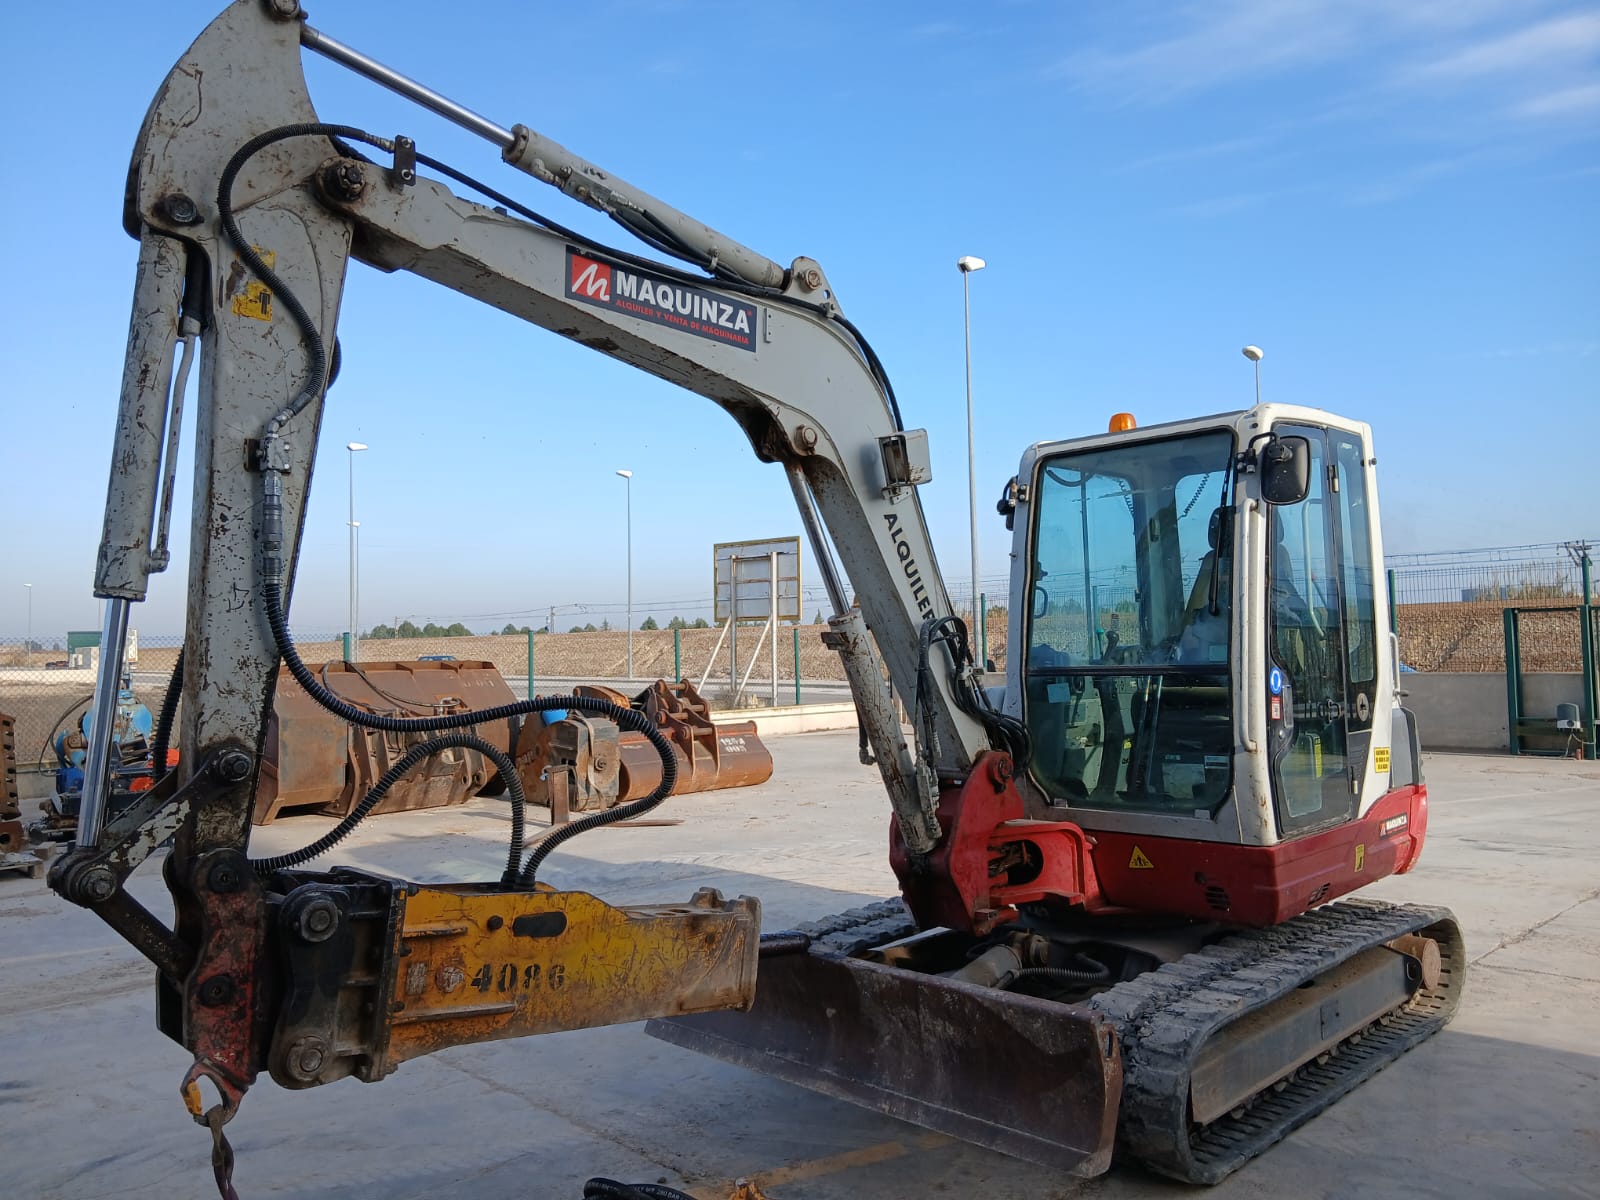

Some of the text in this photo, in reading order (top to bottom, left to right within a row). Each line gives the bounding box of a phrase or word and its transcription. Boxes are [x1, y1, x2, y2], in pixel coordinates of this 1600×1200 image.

[616, 270, 750, 334] MAQUINZA
[616, 300, 654, 317] ALQUILER
[664, 313, 688, 327] VENTA
[690, 321, 700, 330] DE
[702, 325, 749, 344] MAQUINARIA
